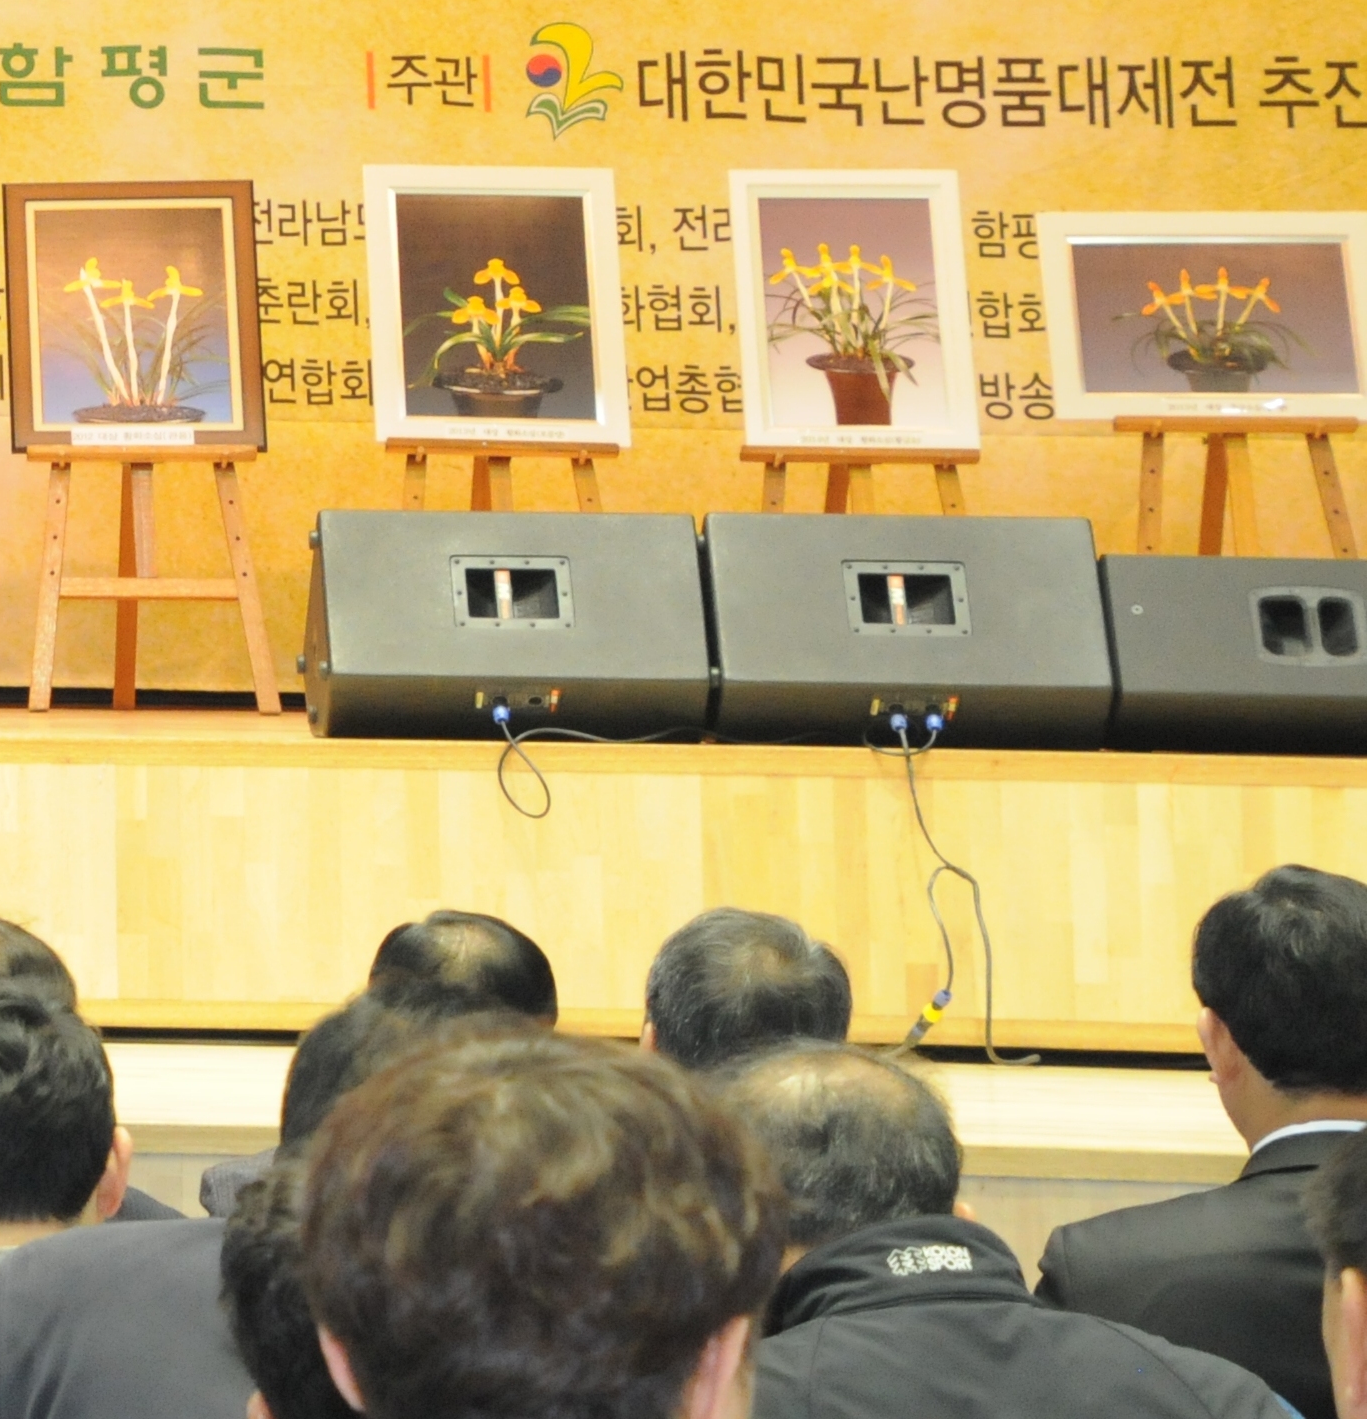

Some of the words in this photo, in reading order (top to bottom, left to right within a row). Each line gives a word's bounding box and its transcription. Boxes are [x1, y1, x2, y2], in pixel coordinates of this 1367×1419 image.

[386, 55, 478, 108] 주관
[637, 48, 1238, 130] 대한민국난명품대제전
[979, 372, 1055, 421] 방송
[921, 1245, 971, 1259] KOLON
[926, 1257, 973, 1272] SPORT
